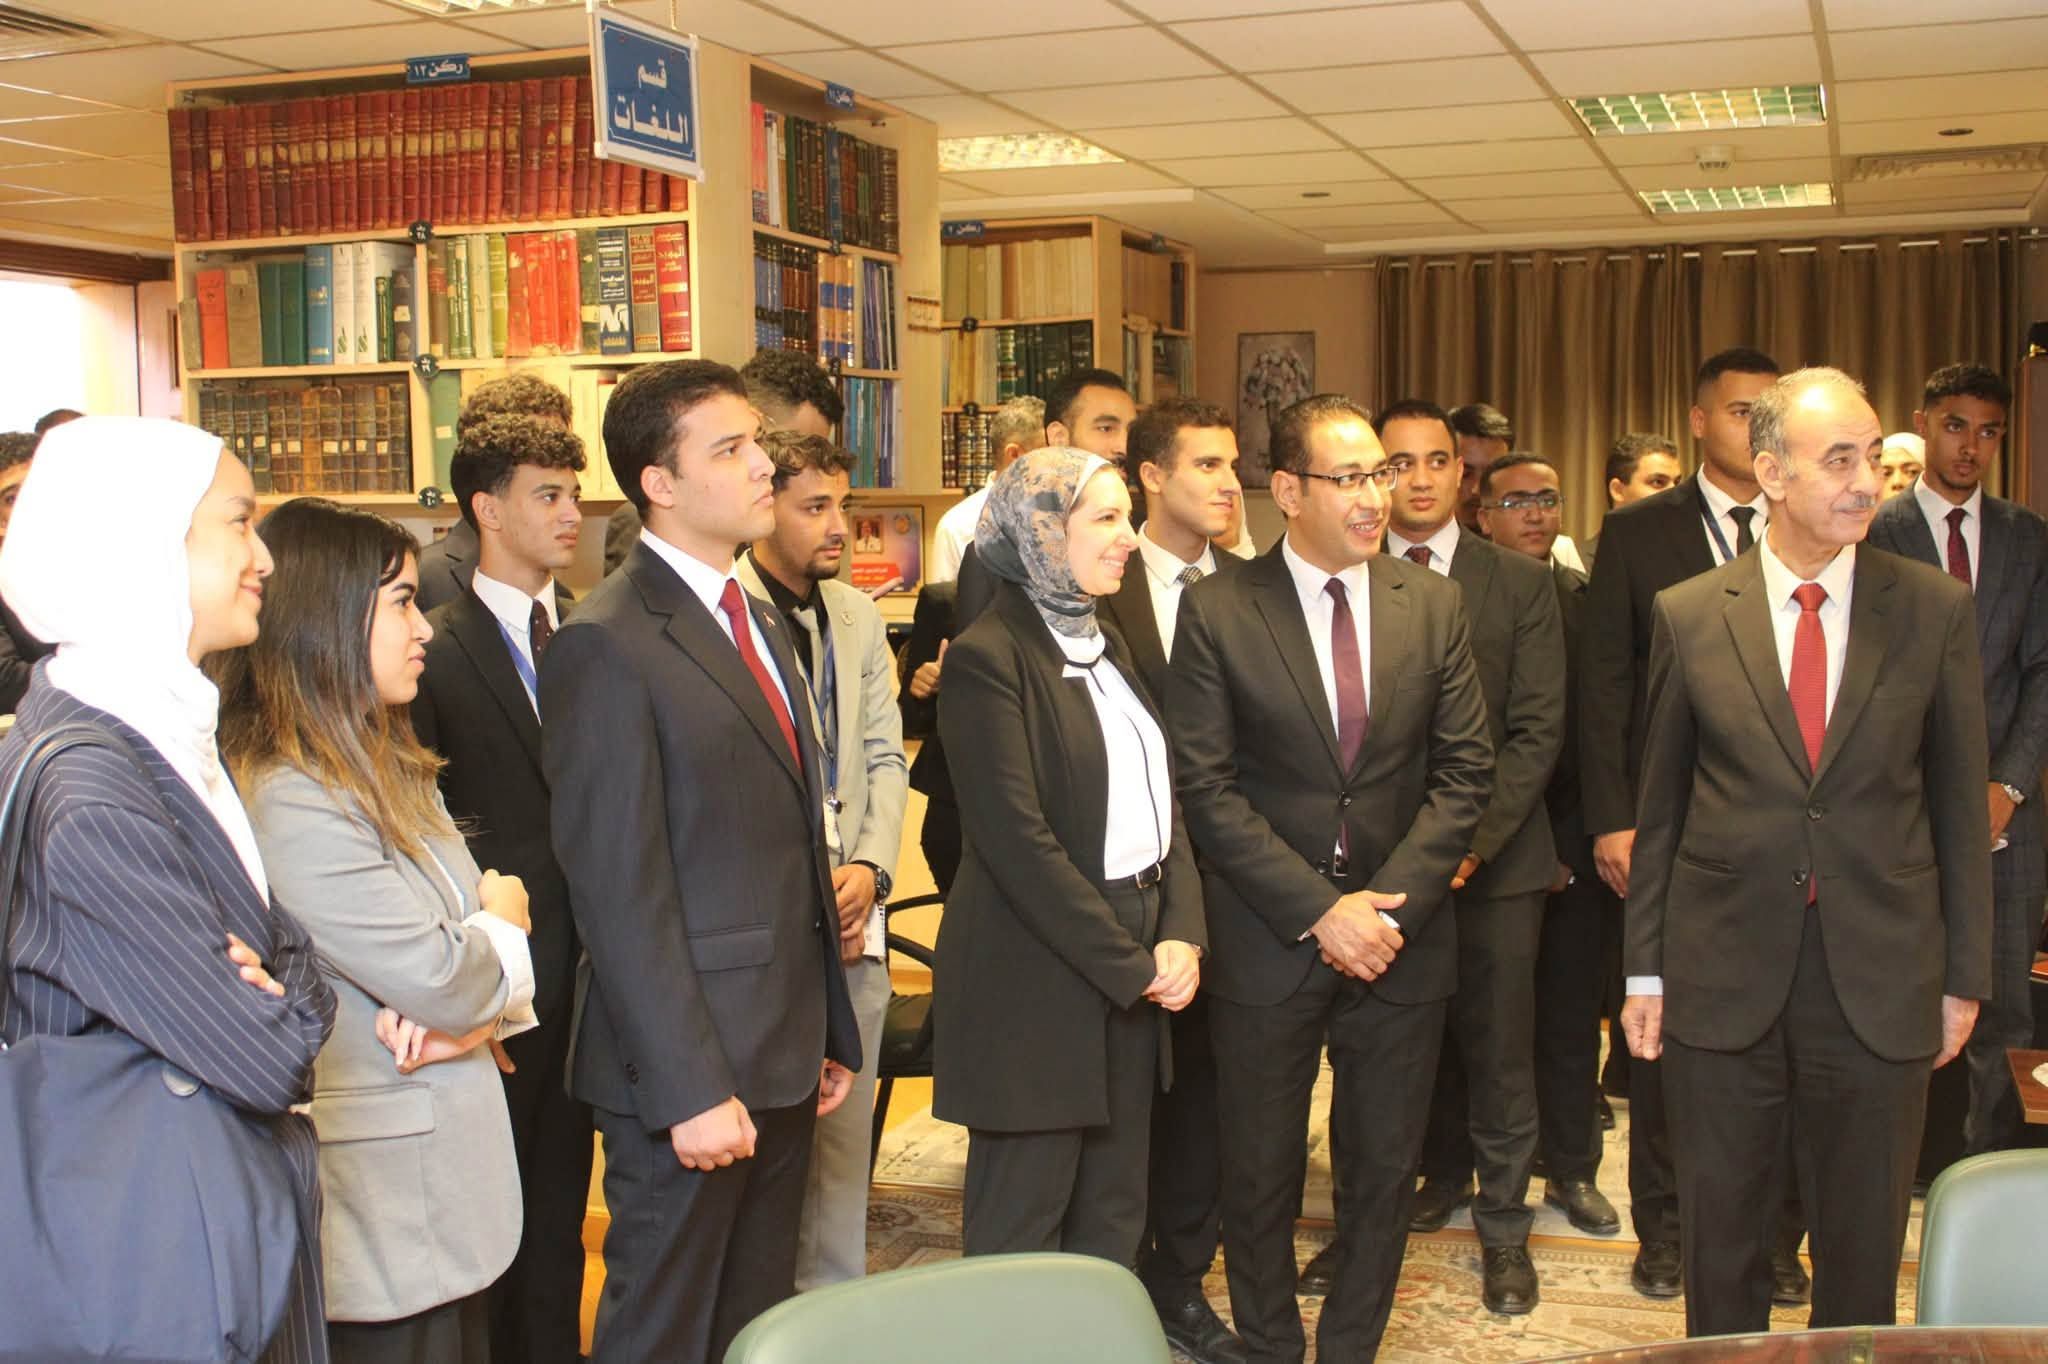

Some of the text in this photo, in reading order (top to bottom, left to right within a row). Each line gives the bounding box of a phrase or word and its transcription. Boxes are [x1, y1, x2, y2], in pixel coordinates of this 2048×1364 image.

[428, 59, 464, 78] ركن
[637, 58, 668, 89] قسم
[613, 95, 689, 145] اللغات
